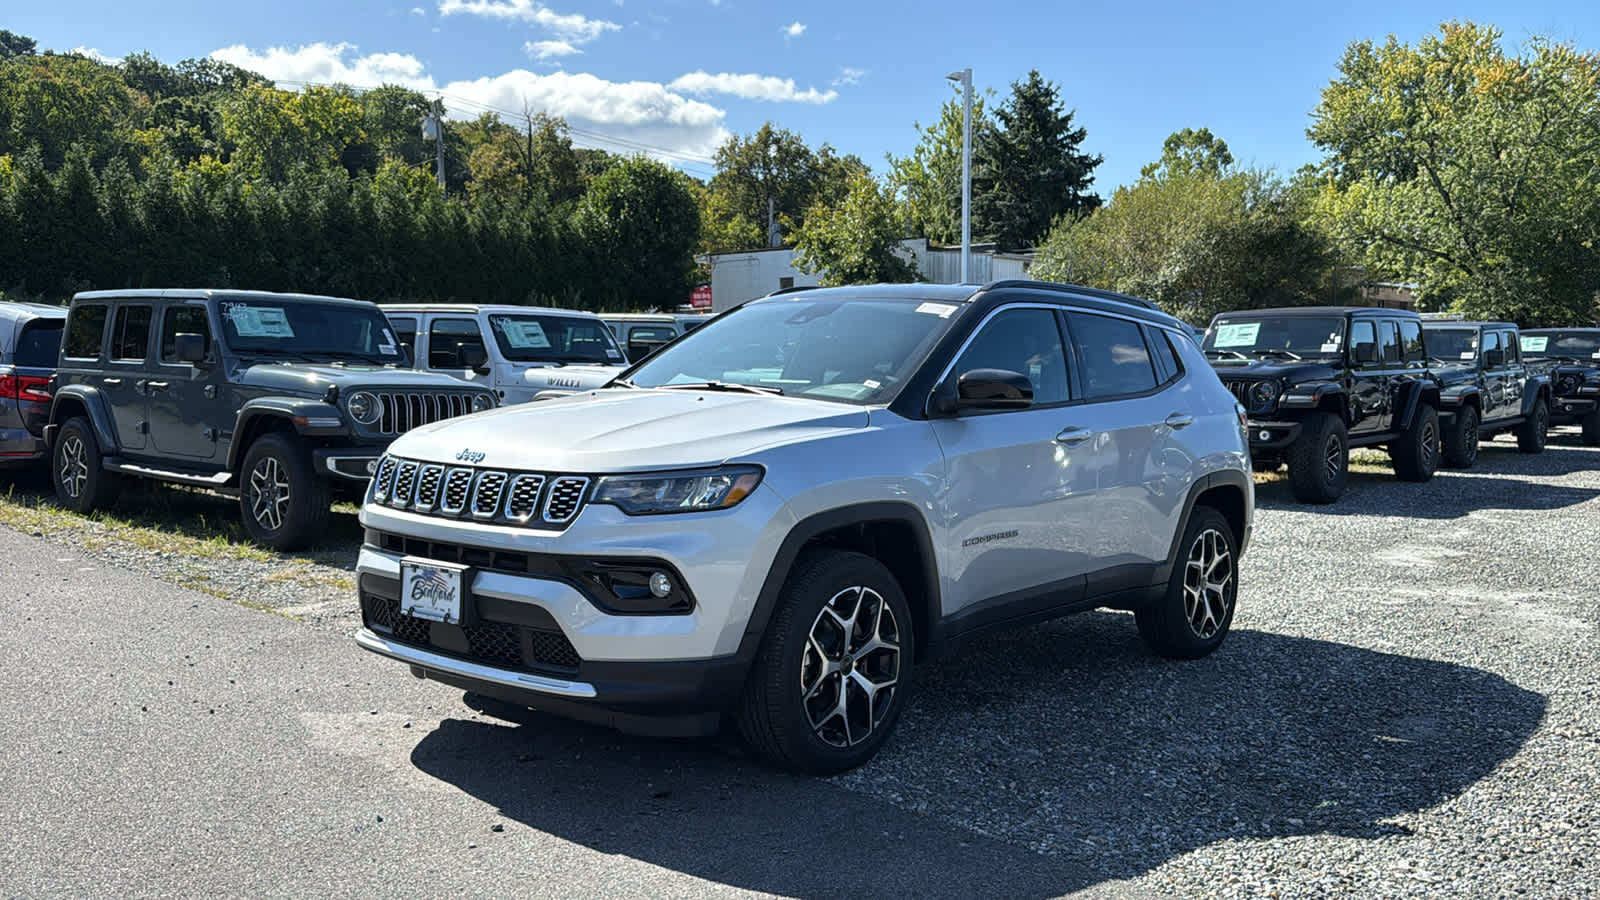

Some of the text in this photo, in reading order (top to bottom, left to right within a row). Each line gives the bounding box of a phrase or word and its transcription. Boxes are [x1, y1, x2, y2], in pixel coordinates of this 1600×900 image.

[456, 448, 486, 464] Jeep
[961, 529, 1018, 547] COMPASS
[411, 579, 456, 606] Bedford
